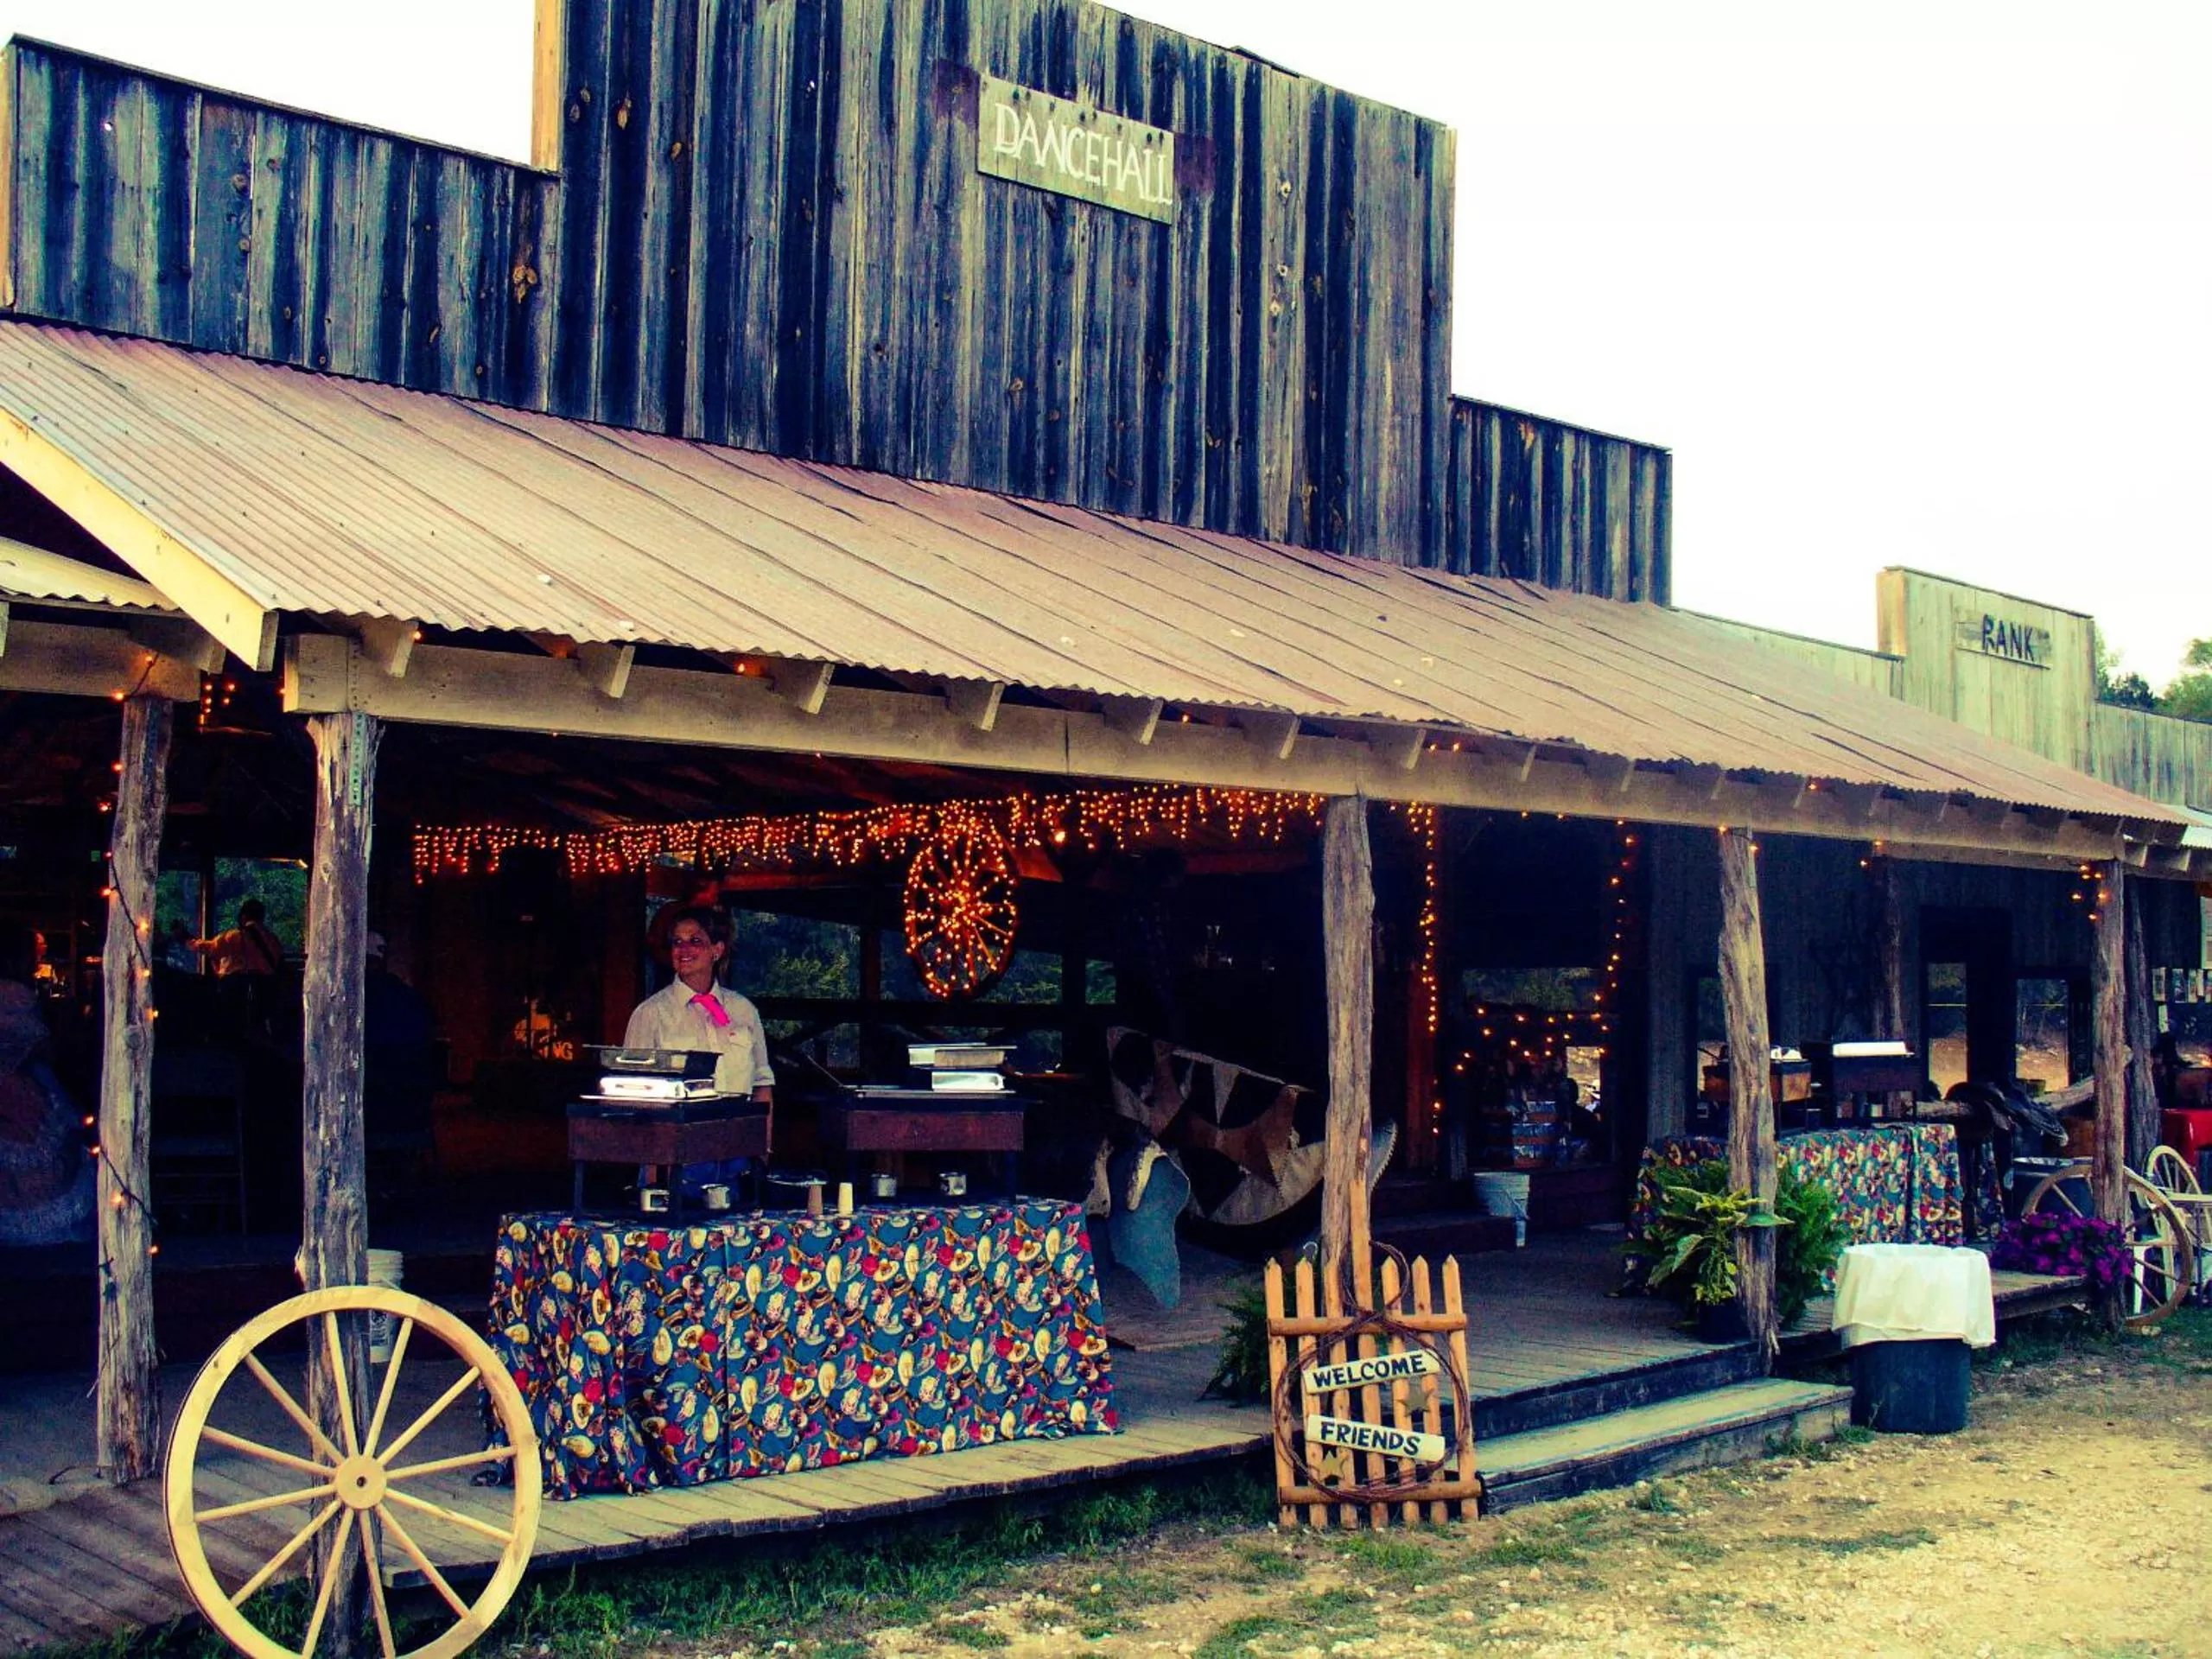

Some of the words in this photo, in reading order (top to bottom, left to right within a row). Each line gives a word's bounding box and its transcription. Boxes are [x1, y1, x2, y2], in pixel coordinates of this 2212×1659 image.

[995, 103, 1173, 205] DANCEHALL
[1313, 1354, 1427, 1389] WELCOME
[1320, 1421, 1421, 1456] FRIENDS
